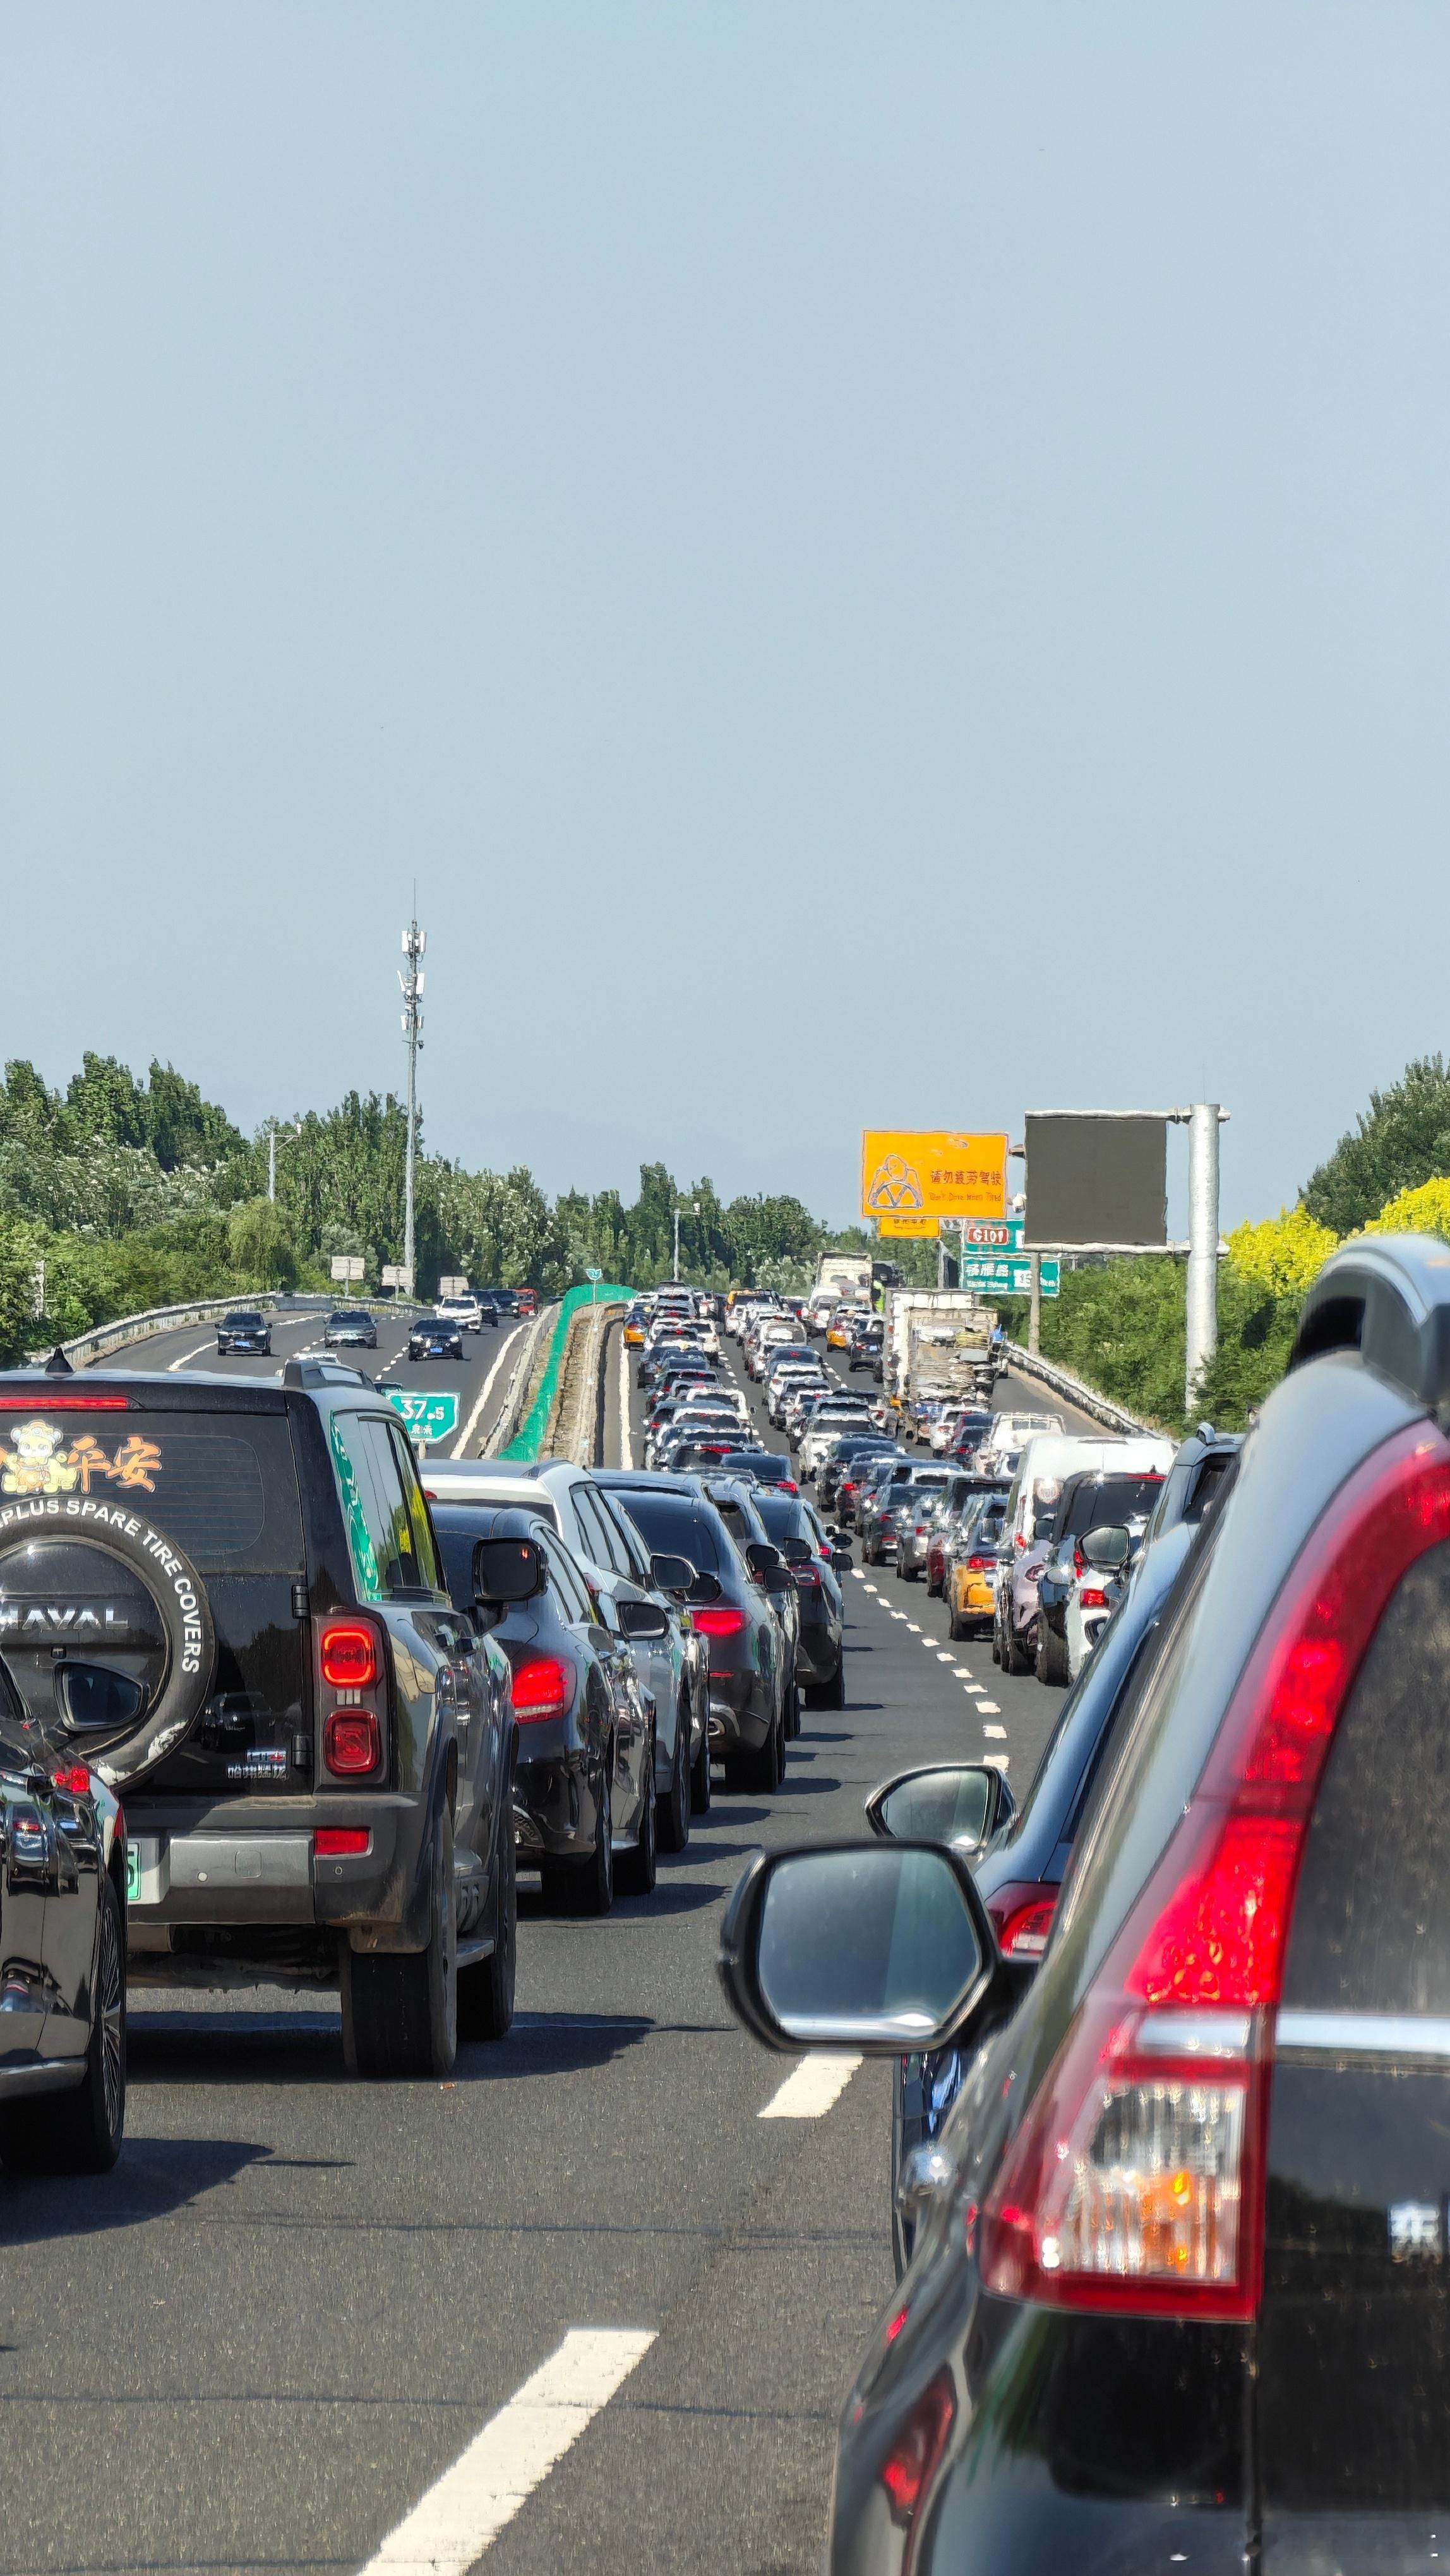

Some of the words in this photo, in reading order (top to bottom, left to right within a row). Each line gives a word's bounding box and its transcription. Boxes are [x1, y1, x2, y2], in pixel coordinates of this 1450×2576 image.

[930, 1170, 1002, 1185] 请勿疲劳驾驶
[400, 1399, 445, 1421] 37.5
[67, 1435, 162, 1493] 平安
[0, 1500, 59, 1528] PLUS
[66, 1500, 141, 1537] SPARE
[141, 1529, 183, 1577] TIRE
[174, 1578, 202, 1673] COVERS
[0, 1606, 130, 1630] HAVAL
